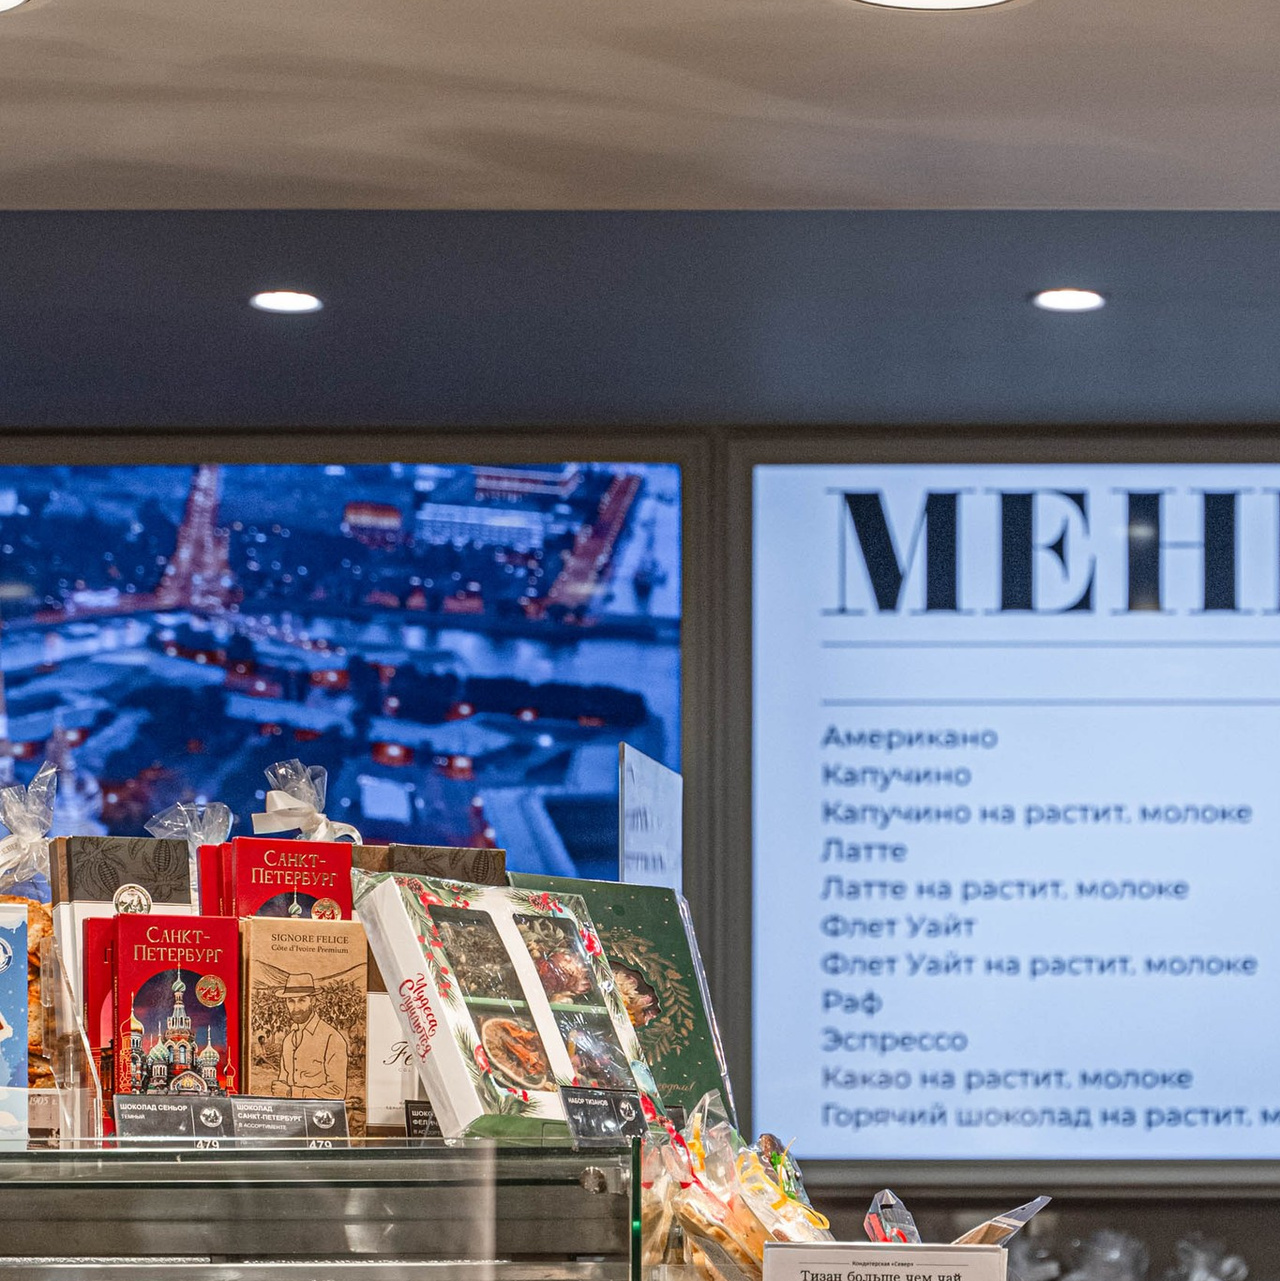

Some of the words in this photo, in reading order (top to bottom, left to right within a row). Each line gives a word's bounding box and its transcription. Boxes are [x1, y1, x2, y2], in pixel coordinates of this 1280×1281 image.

[820, 724, 998, 753] Американо
[821, 763, 972, 793] Капучино
[821, 800, 972, 830] Капучино
[979, 805, 1016, 824] на
[1138, 804, 1253, 824] молоке
[820, 837, 908, 863] Латте
[251, 868, 338, 887] ПЕТЕРБУРГ
[820, 875, 908, 901] Латте
[916, 880, 952, 900] на
[1076, 879, 1190, 900] молоке
[820, 913, 899, 938] Флет
[905, 913, 976, 938] Уайт
[271, 933, 315, 943] SIGNORE
[316, 935, 349, 945] FELICE
[271, 943, 287, 952] Côte
[317, 946, 349, 954] Premium
[134, 944, 224, 963] ПЕТЕРБУРГ
[820, 951, 899, 976] Флет
[905, 951, 976, 976] Уайт
[984, 956, 1021, 976] на
[1144, 956, 1258, 976] молоке
[416, 973, 438, 1038] Чудеса
[821, 989, 883, 1018] Раф
[398, 979, 432, 1064] Случаются
[822, 1026, 968, 1056] Эспрессо
[822, 1066, 912, 1090] Какао
[919, 1070, 956, 1090] на
[1079, 1069, 1194, 1090] молоке
[119, 1103, 157, 1112] ШОКОЛАД
[157, 1104, 188, 1112] СЕНЬОР
[236, 1104, 273, 1113] ШОКОЛАД
[237, 1113, 303, 1122] САНКТ-ПЕТЕРБУРГ
[821, 1102, 947, 1132] Горячий
[955, 1106, 1093, 1129] шоколад
[1099, 1107, 1137, 1127] на
[800, 1270, 842, 1281] Тизан
